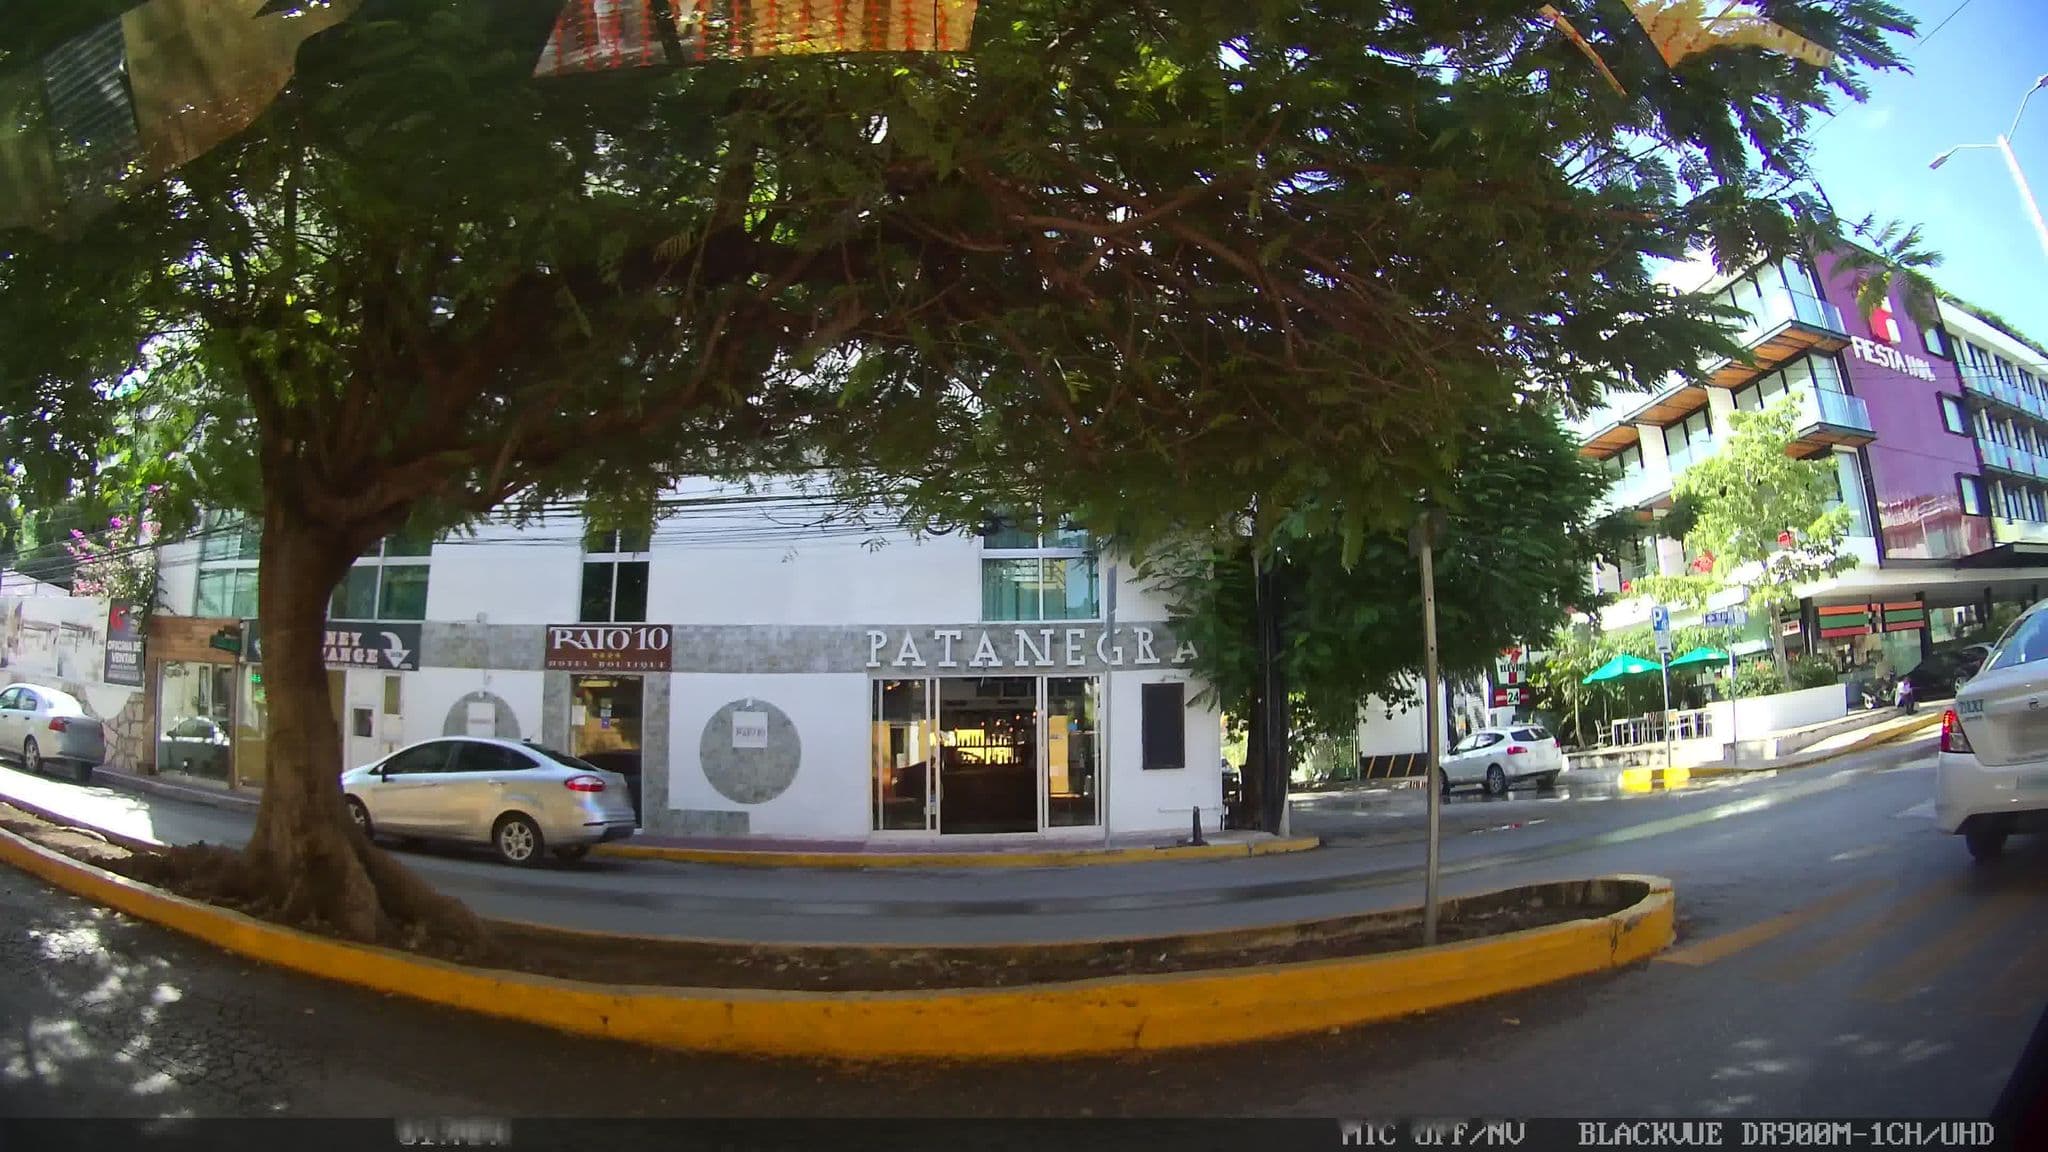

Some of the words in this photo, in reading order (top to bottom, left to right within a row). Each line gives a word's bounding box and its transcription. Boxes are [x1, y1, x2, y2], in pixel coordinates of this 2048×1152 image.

[324, 630, 362, 646] NEY
[634, 627, 669, 650] 10
[133, 640, 142, 652] DE
[111, 652, 137, 664] VENTAS
[322, 646, 378, 663] ANGE
[1507, 691, 1519, 703] 24
